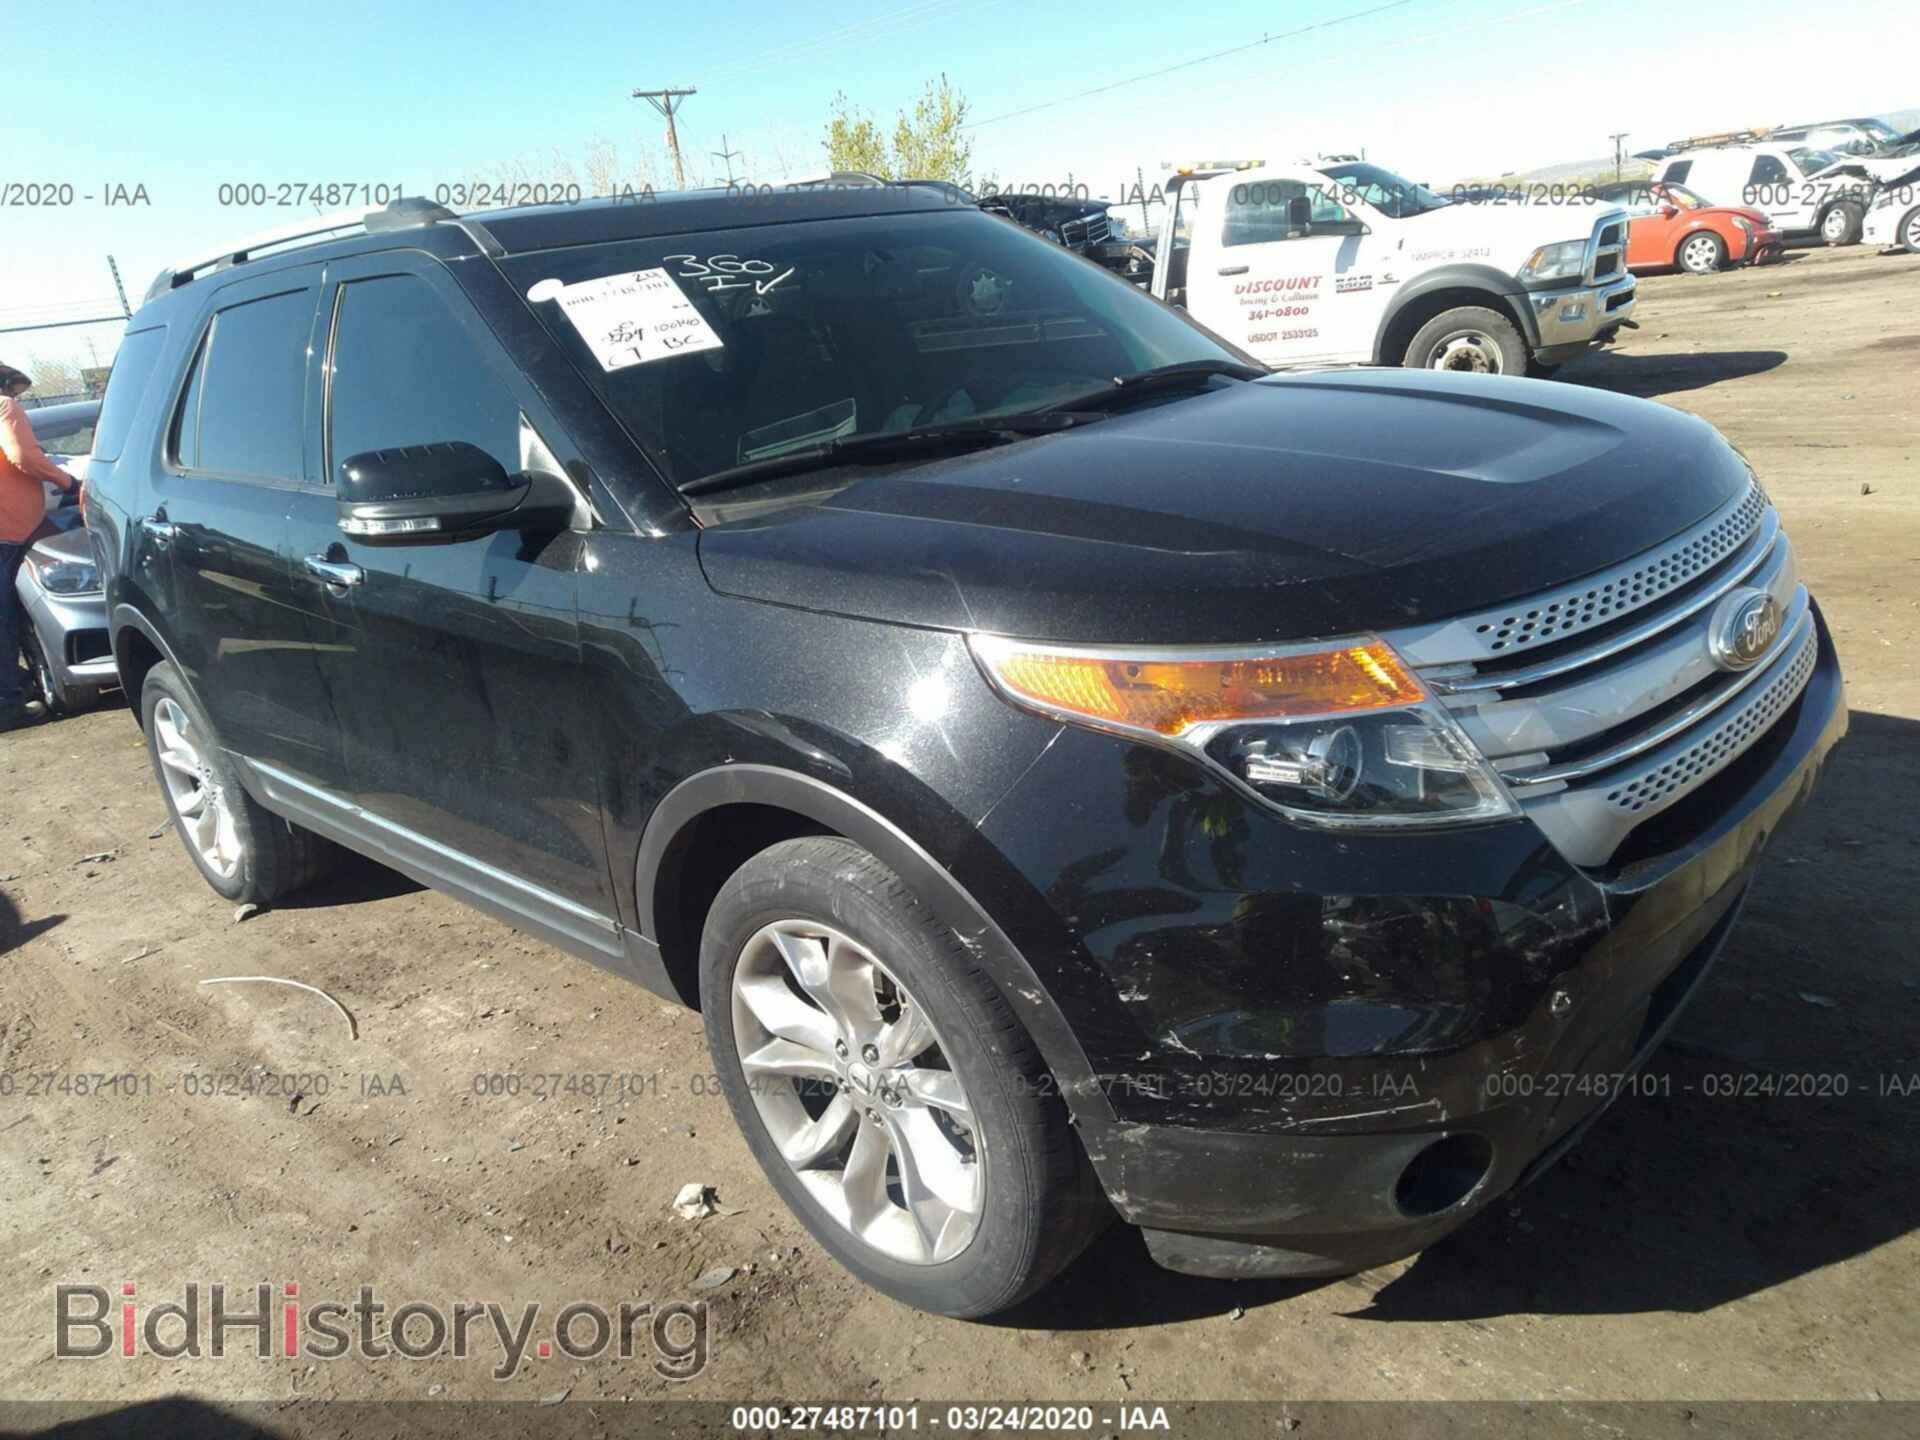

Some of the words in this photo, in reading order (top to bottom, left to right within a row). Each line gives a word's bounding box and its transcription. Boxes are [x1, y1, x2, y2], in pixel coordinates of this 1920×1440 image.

[1234, 275, 1323, 295] DISCOUNT
[1248, 306, 1309, 321] 341-0800
[1248, 332, 1279, 344] USDOT
[1744, 598, 1777, 652] Ford
